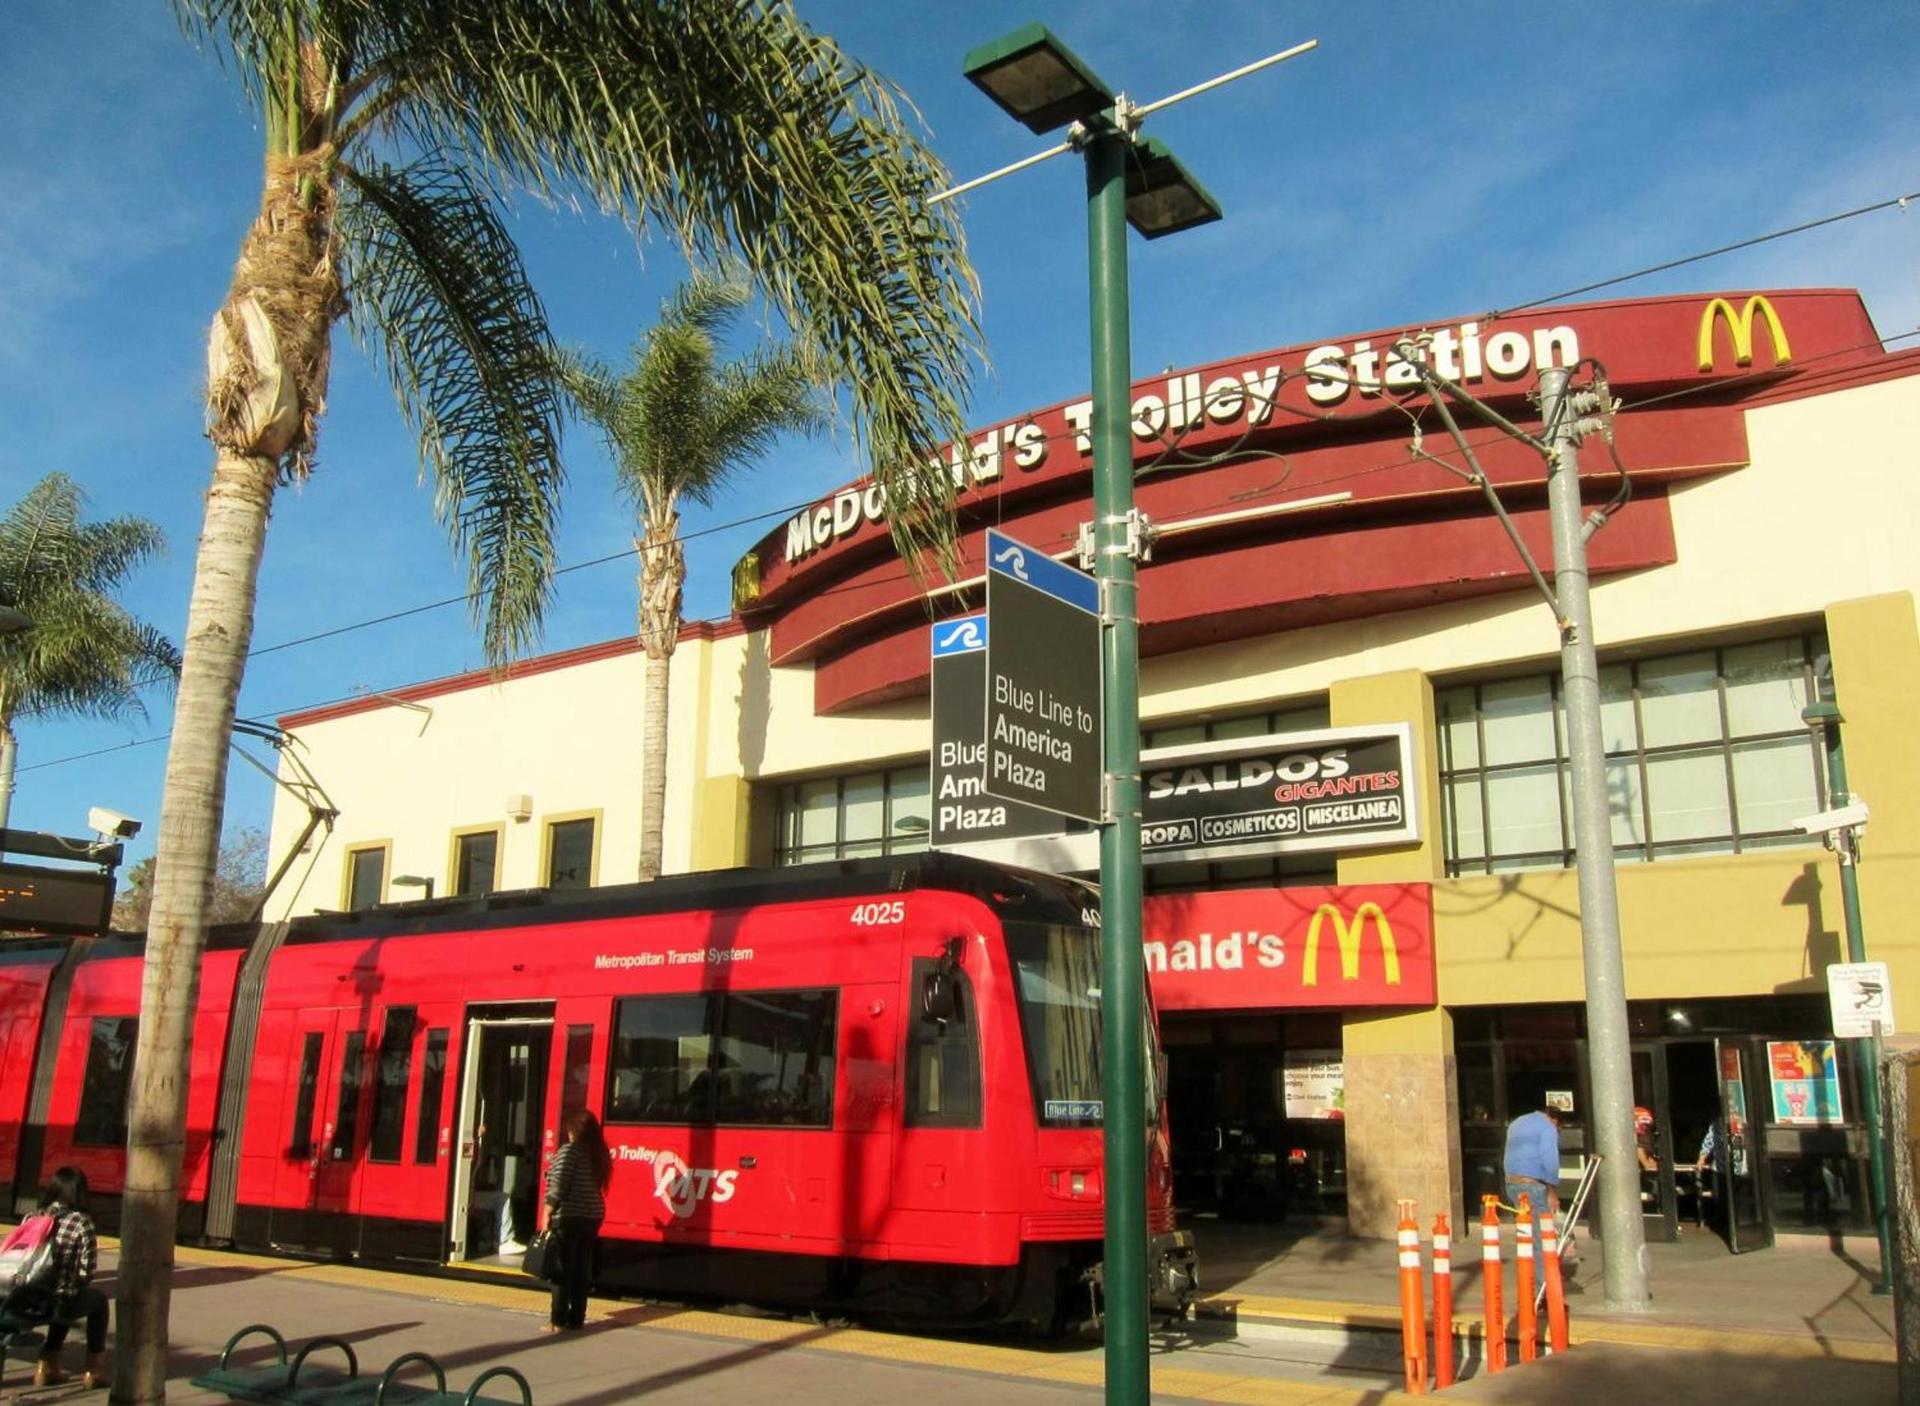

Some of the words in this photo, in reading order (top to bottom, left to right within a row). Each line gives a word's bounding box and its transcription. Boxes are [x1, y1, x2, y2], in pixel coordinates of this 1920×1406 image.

[786, 423, 1044, 562] McDold's
[1065, 366, 1281, 451] Tolley
[1304, 322, 1579, 402] Station
[995, 674, 1033, 713] Blue
[1039, 690, 1073, 727] Line
[1076, 705, 1093, 733] to
[941, 741, 986, 767] Blue
[993, 713, 1072, 763] America
[938, 774, 985, 799] Am
[993, 750, 1046, 792] Plaza
[1149, 749, 1350, 799] SALDOS
[1273, 770, 1400, 802] GIGANTES
[939, 805, 1006, 832] Plaza
[1141, 824, 1195, 846] ROPA
[1202, 811, 1297, 838] COSMETICOS
[1307, 799, 1399, 826] MISCELANEA
[850, 902, 905, 926] 4025
[595, 952, 665, 970] Metropolitan
[667, 948, 705, 965] Transit
[707, 947, 754, 966] System
[619, 1145, 658, 1164] Trolley
